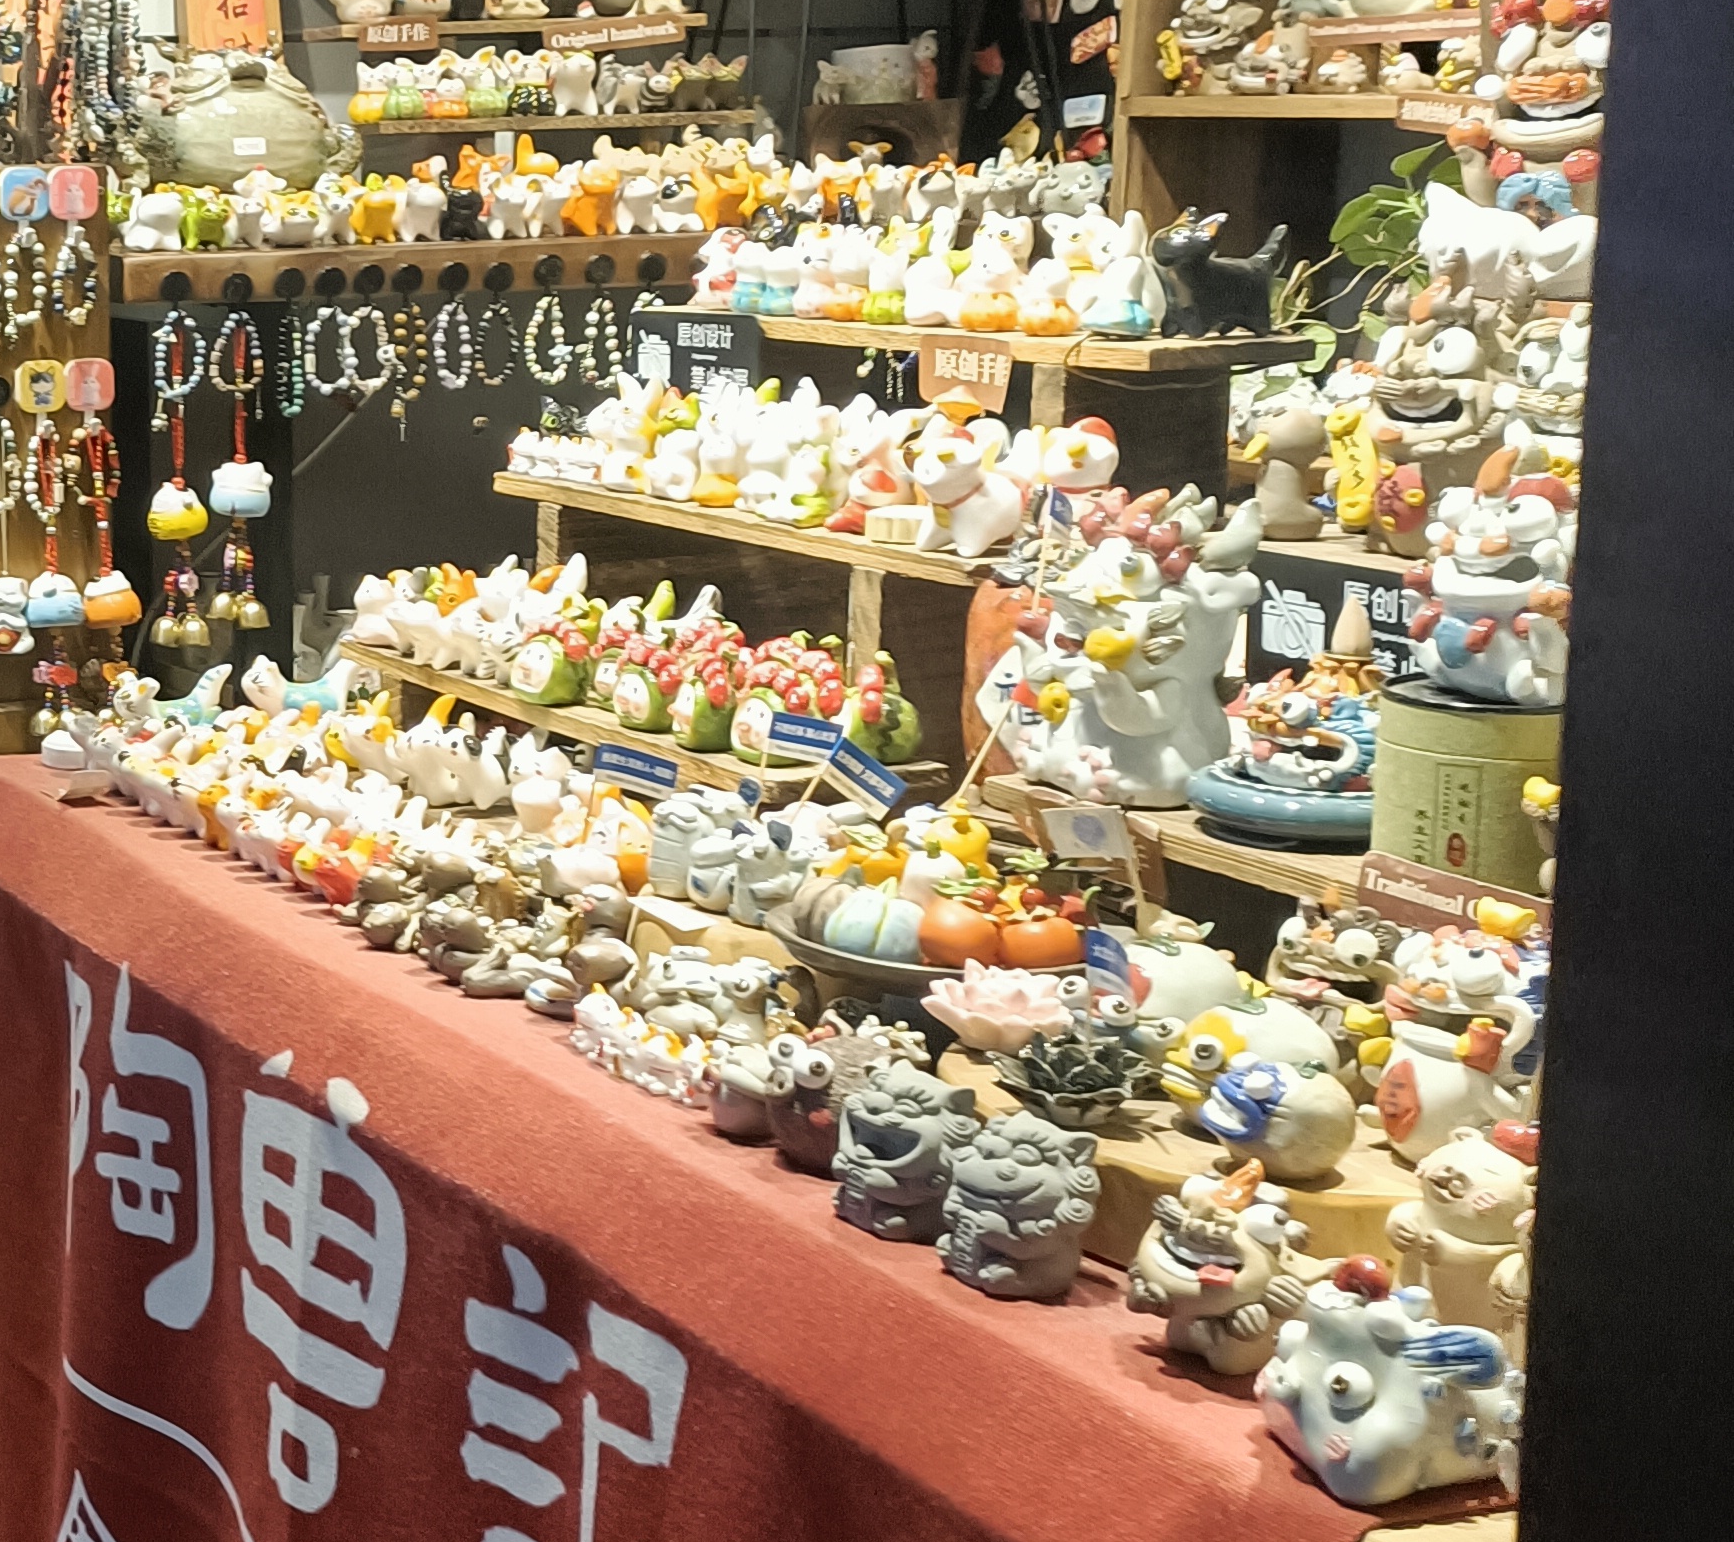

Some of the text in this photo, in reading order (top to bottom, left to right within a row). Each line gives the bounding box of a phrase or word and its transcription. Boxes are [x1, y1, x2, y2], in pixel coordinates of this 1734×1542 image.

[367, 21, 431, 44] 原创手作
[550, 27, 609, 48] Original
[677, 321, 735, 350] 原创设计
[933, 347, 1008, 387] 原创手作
[1365, 867, 1465, 916] Traditional
